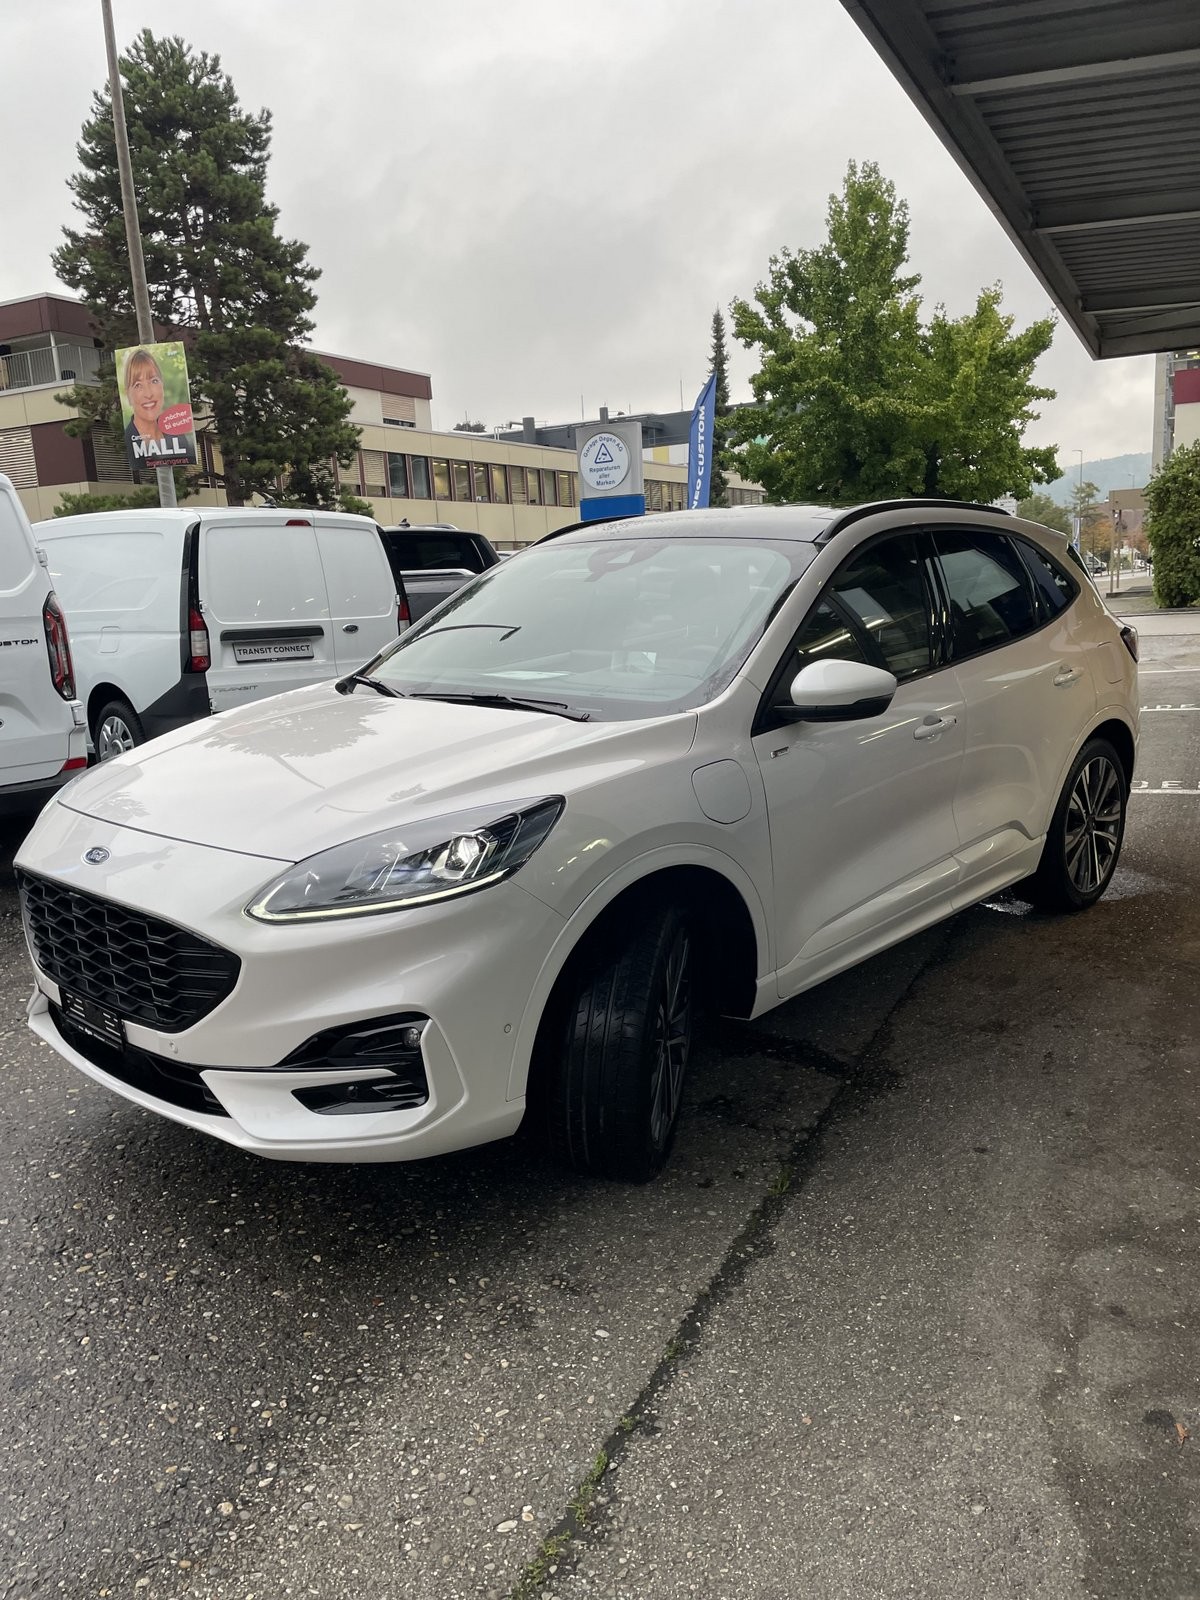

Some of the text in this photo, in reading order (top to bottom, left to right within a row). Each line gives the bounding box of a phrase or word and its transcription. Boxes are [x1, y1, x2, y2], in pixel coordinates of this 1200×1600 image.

[698, 405, 706, 476] CUSTOM
[132, 437, 187, 459] MALL
[589, 465, 621, 473] Reparaturen
[596, 479, 616, 487] Marken
[0, 638, 39, 647] STOM
[236, 644, 310, 656] TRANSIT CONNECT
